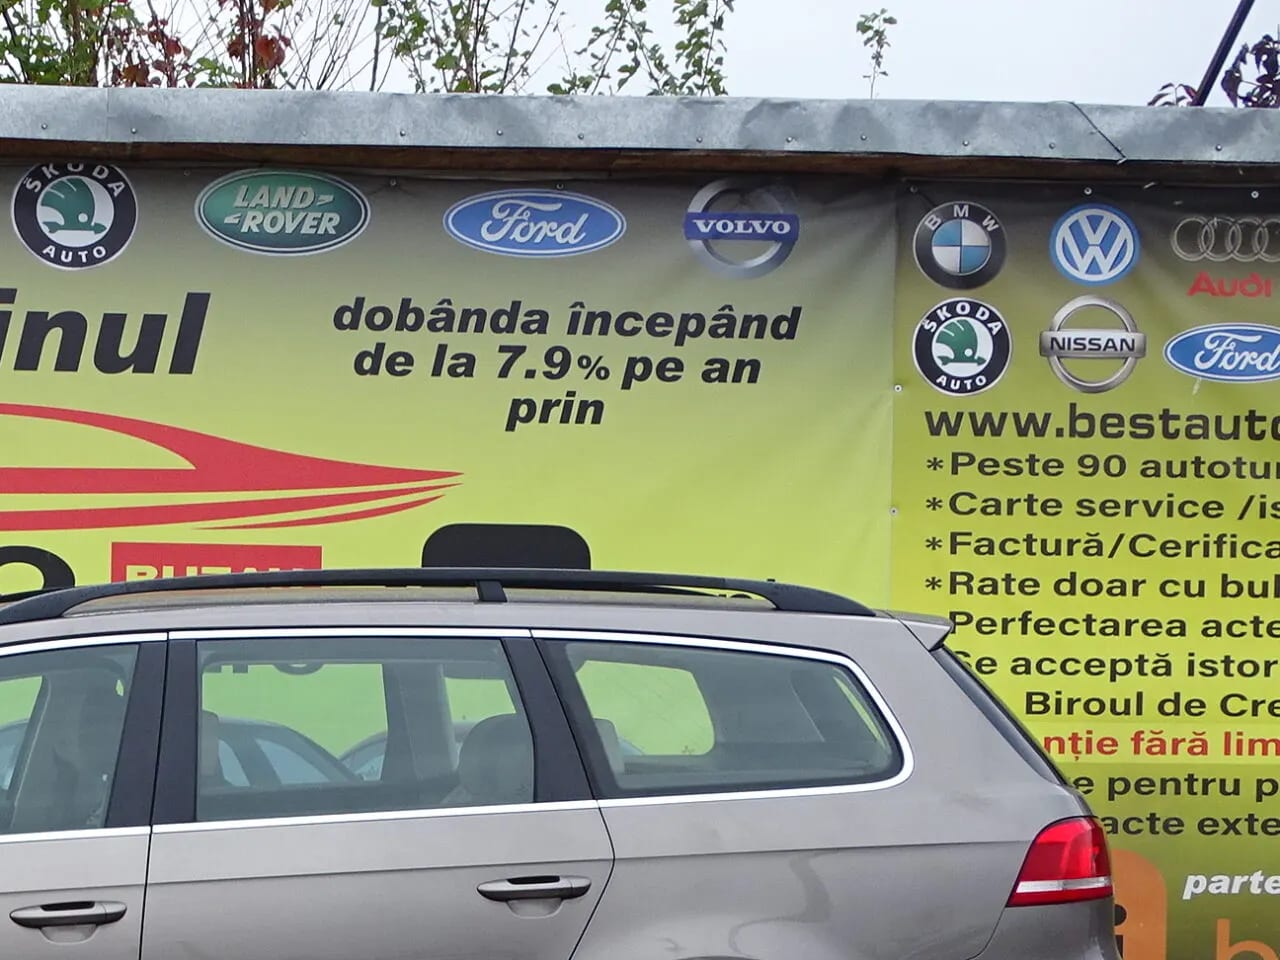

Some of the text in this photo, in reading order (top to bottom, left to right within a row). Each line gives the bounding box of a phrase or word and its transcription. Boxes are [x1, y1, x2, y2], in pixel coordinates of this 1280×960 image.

[233, 184, 314, 210] LAND
[239, 210, 342, 236] ROVER
[480, 198, 590, 245] Ford
[692, 216, 792, 238] VOLVO
[924, 203, 1000, 233] BMW
[42, 244, 107, 263] AUTO
[1186, 271, 1272, 298] Audi
[332, 296, 802, 347] dobânda începând
[1049, 337, 1136, 353] NISSAN
[1193, 331, 1280, 372] Ford
[353, 342, 762, 390] de la 7.9% pe an
[936, 375, 987, 390] AUTO
[504, 390, 606, 432] prin
[1077, 453, 1127, 478] 90
[1075, 493, 1225, 519] service
[1053, 572, 1147, 597] doar
[1159, 577, 1206, 598] cu
[949, 610, 1187, 638] Perfectarea
[1010, 652, 1173, 683] acceptă
[1187, 652, 1278, 678] istor
[1025, 691, 1144, 716] Biroul
[1157, 692, 1207, 717] de
[1130, 729, 1209, 756] fără
[1107, 773, 1241, 802] pentru
